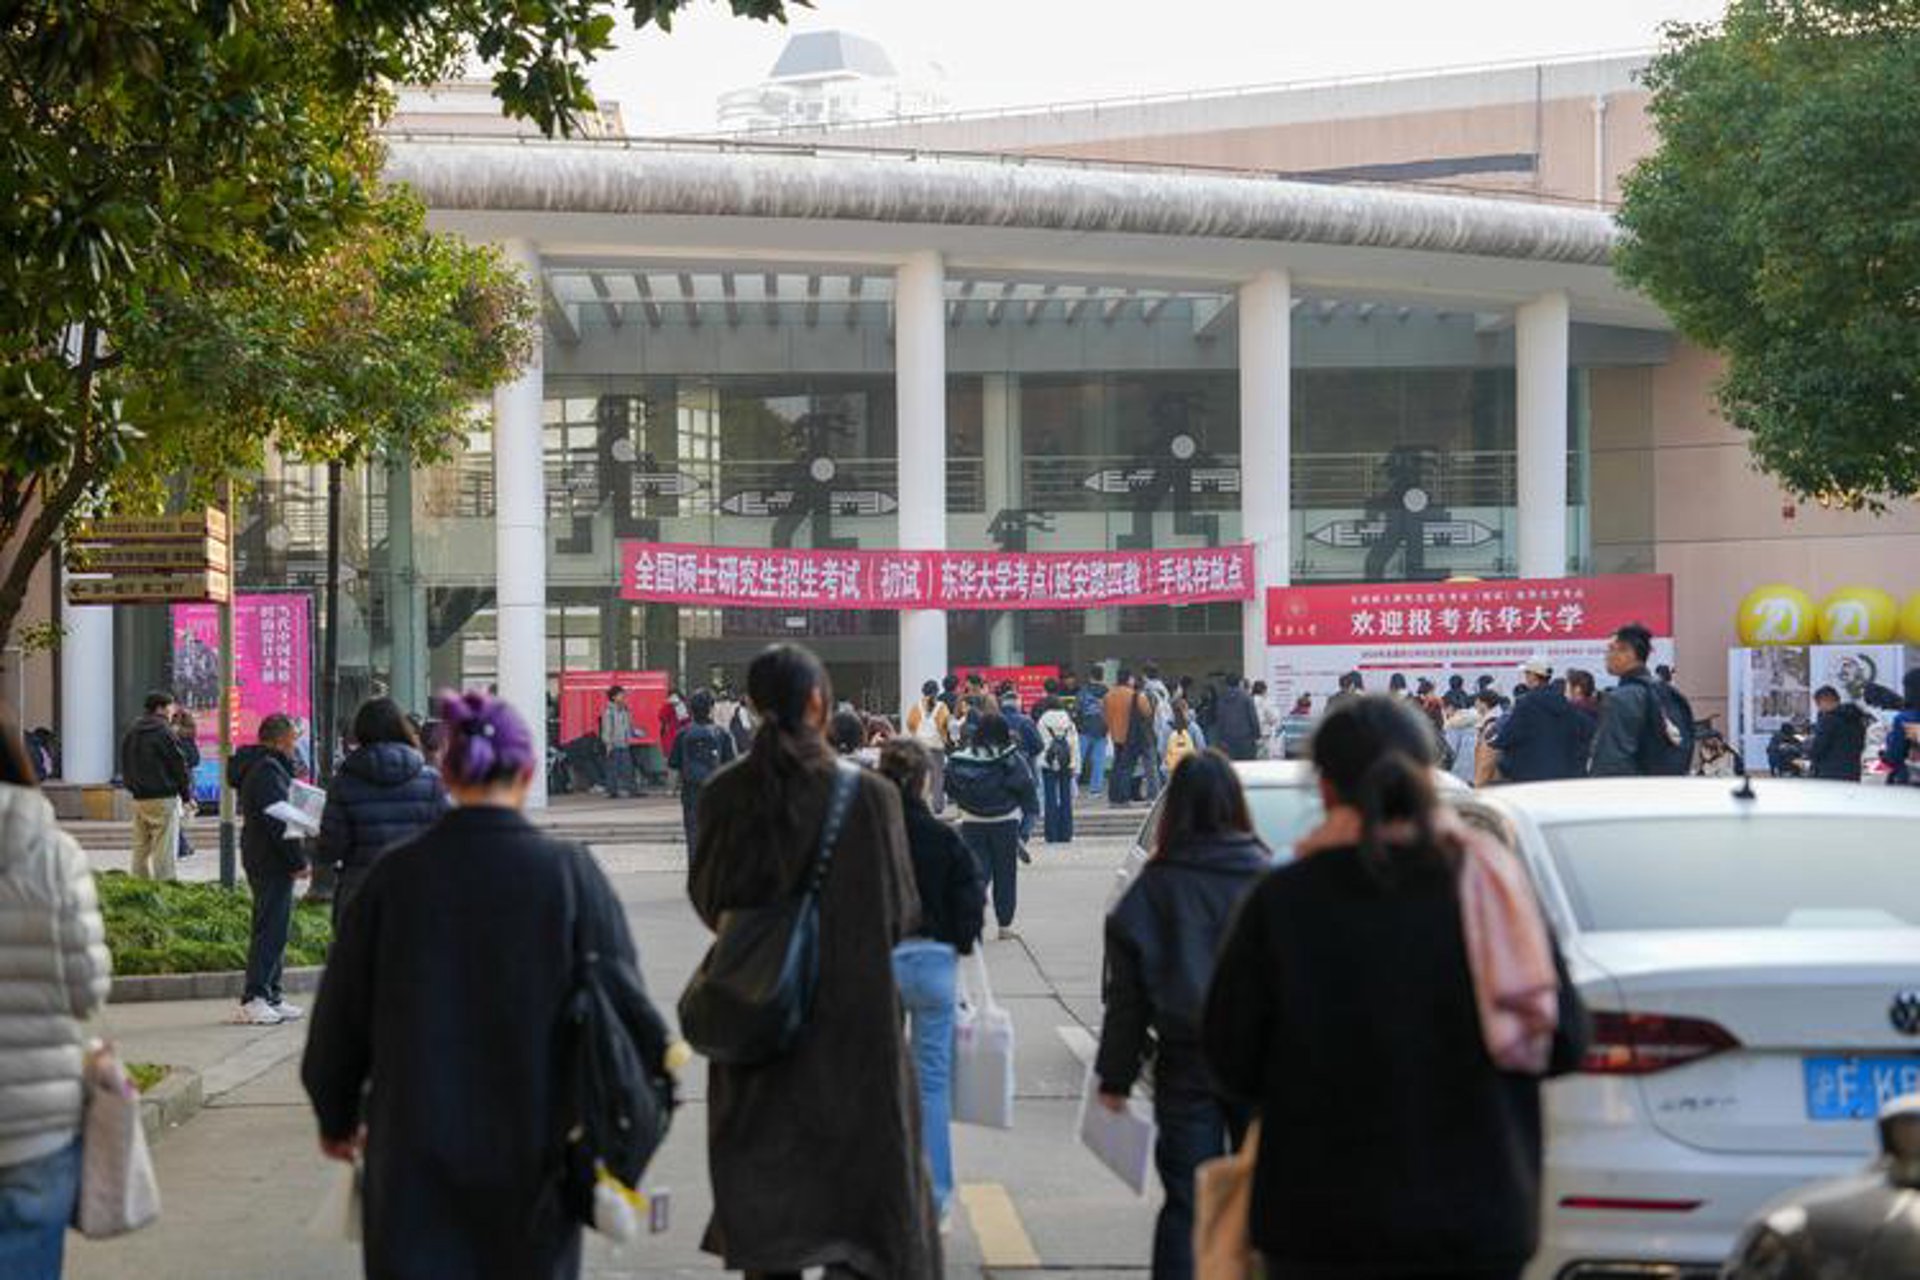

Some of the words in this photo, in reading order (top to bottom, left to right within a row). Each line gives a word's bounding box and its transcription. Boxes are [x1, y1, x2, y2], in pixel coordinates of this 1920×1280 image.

[1350, 603, 1584, 637] 欢迎报考东华大学
